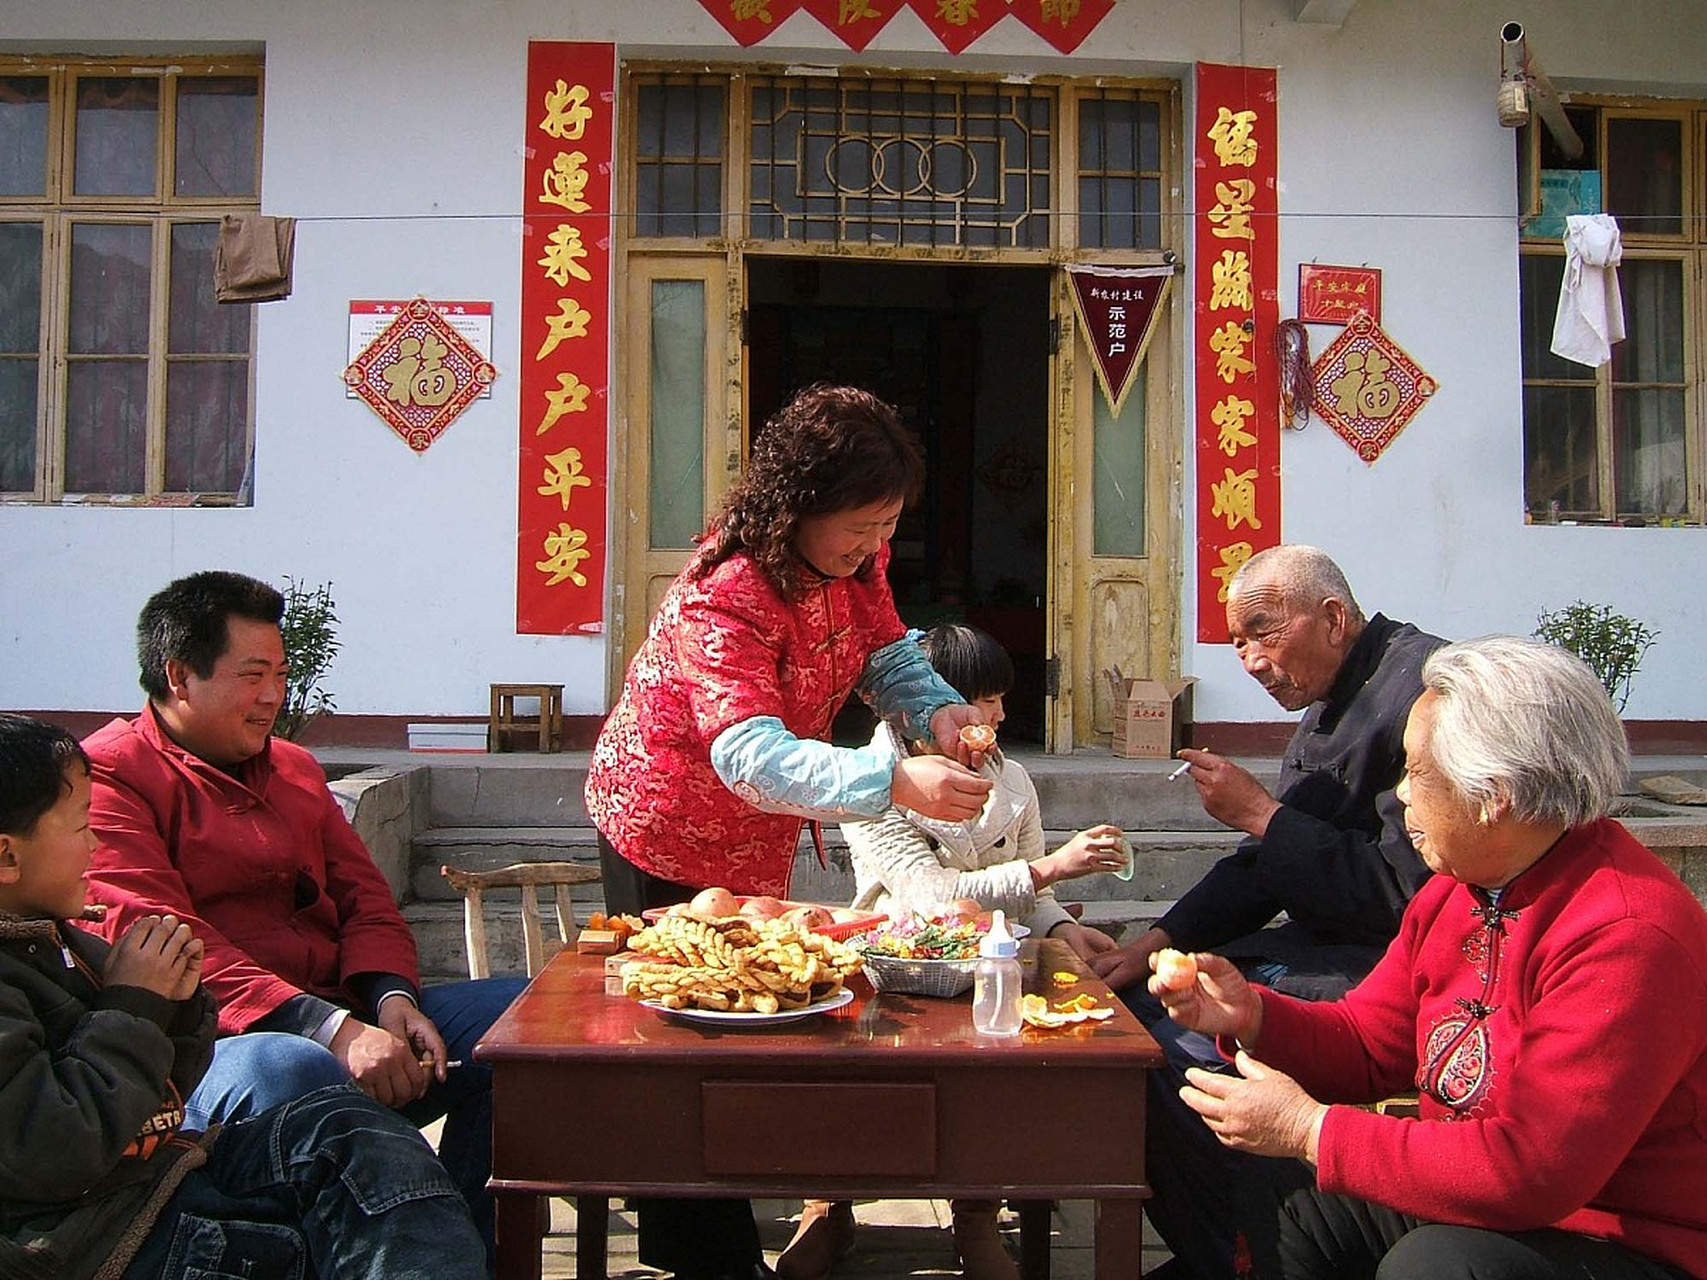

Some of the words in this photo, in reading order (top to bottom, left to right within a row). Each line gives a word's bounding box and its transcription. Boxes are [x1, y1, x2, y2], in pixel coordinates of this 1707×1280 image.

[1108, 306, 1127, 358] 示范户
[383, 333, 457, 408] 福
[1331, 349, 1401, 418] 福
